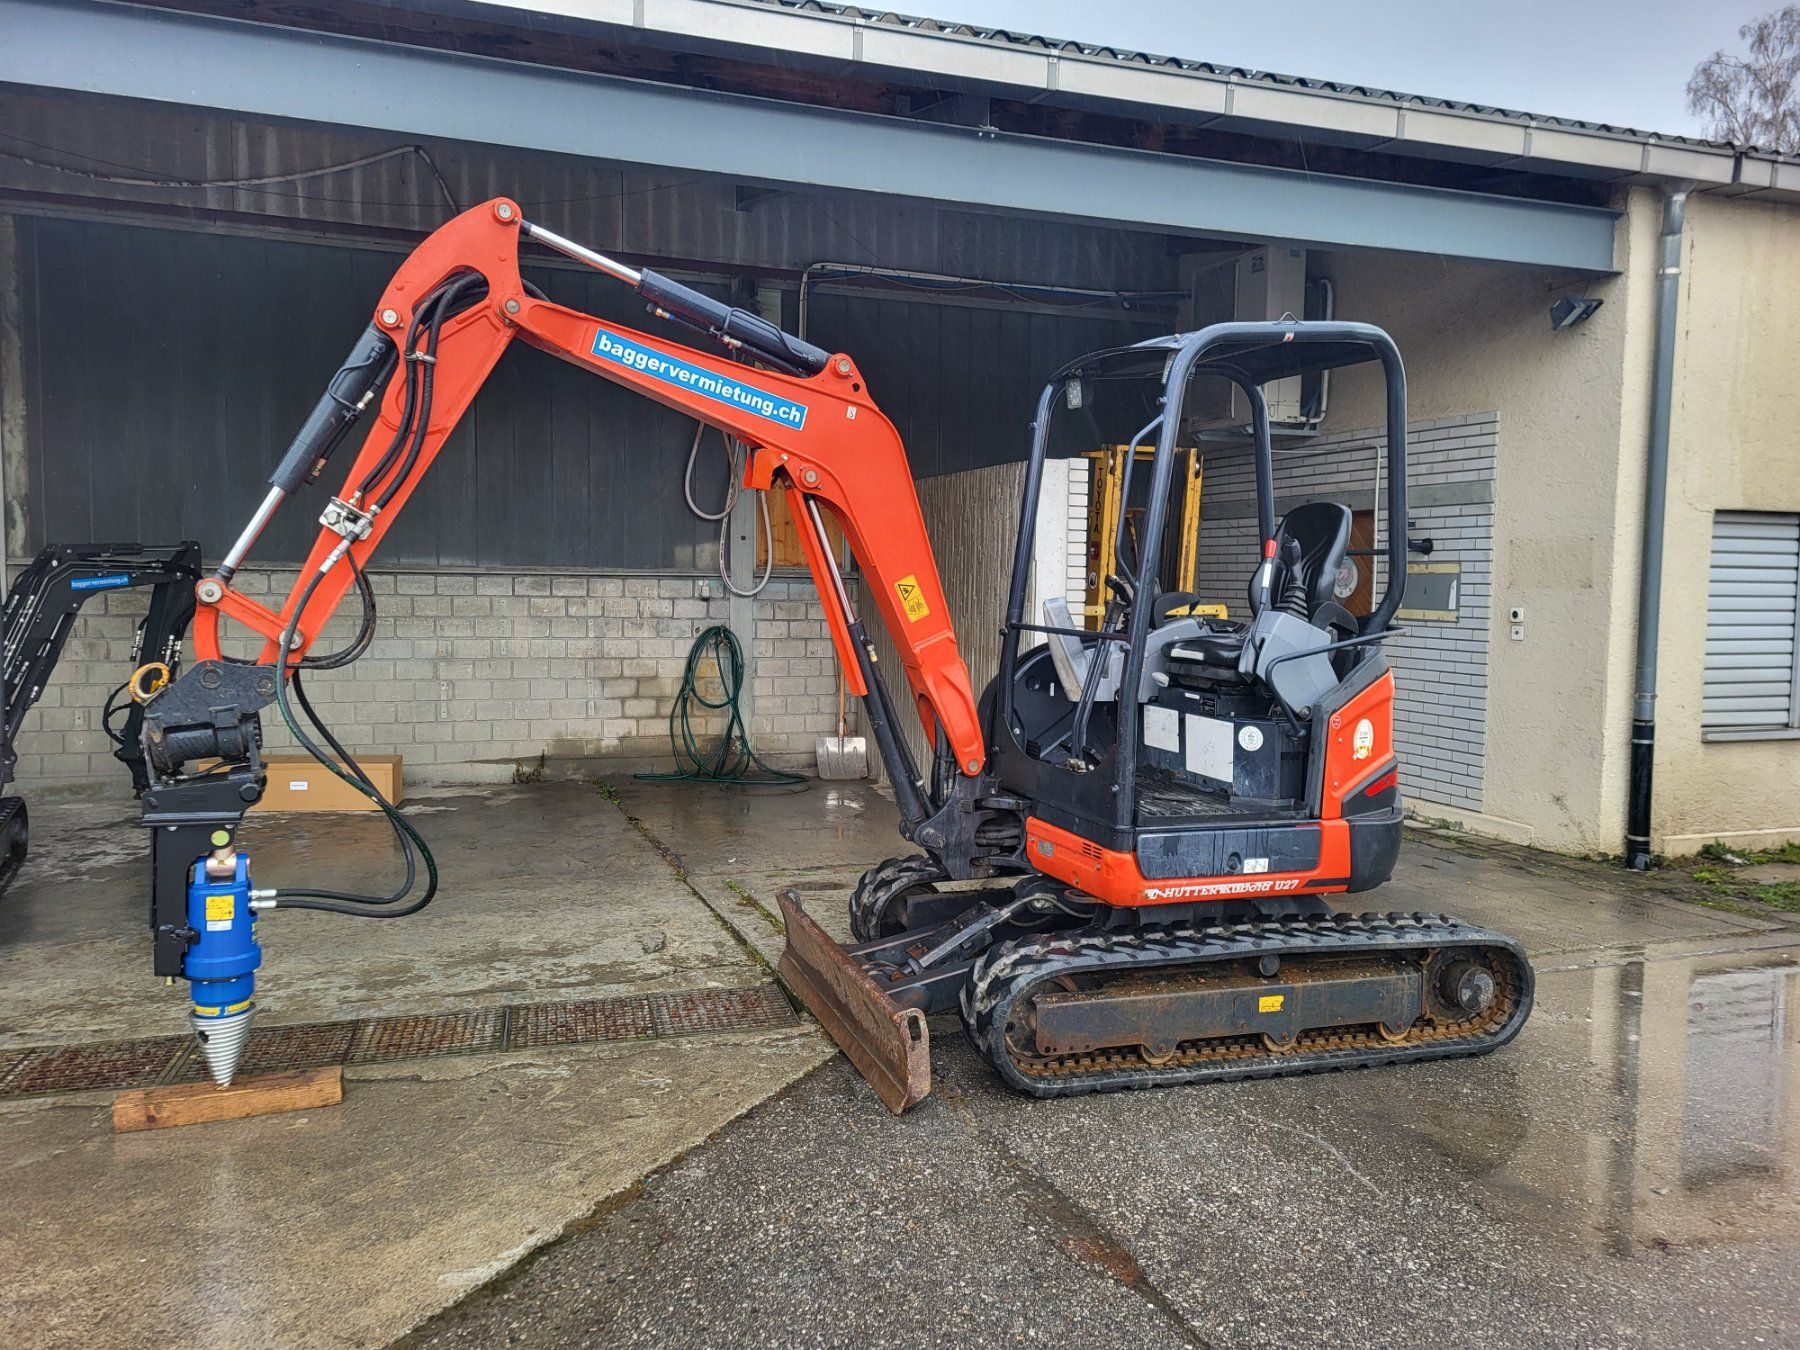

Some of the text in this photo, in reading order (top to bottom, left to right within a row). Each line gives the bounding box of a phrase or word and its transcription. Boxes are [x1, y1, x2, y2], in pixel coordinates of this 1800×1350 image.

[598, 335, 801, 423] baggervermietung.ch
[1093, 467, 1104, 533] TOYOTA
[1274, 879, 1300, 891] U27
